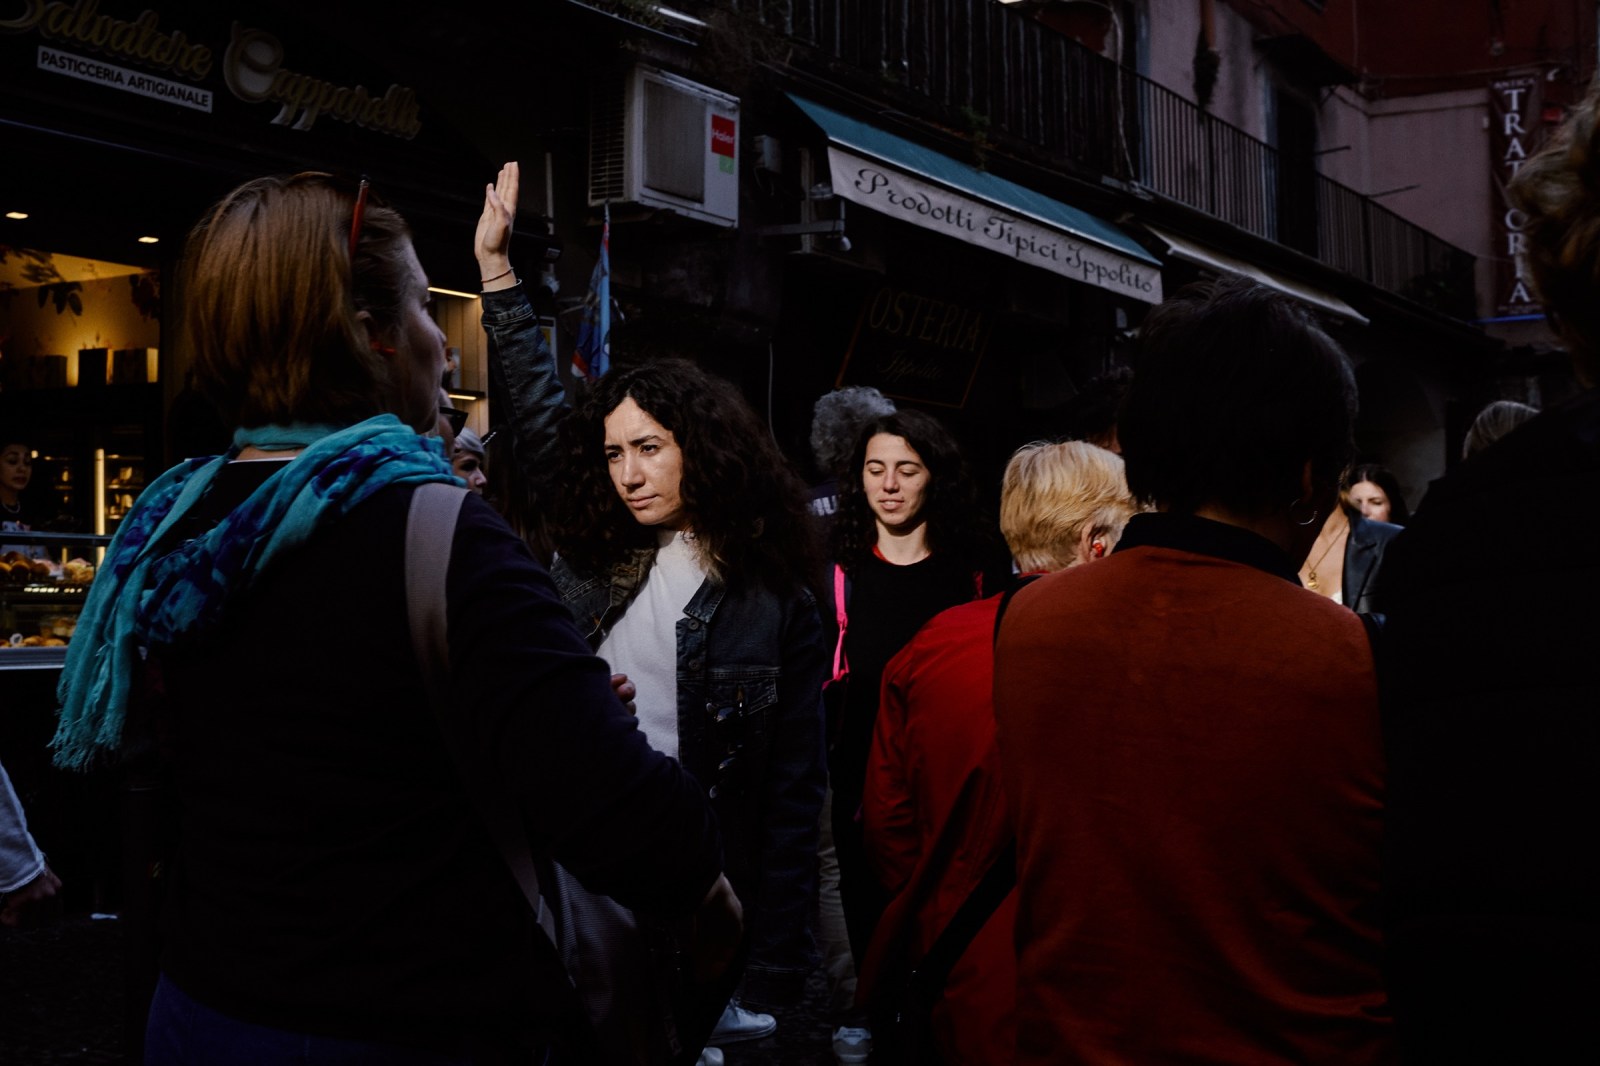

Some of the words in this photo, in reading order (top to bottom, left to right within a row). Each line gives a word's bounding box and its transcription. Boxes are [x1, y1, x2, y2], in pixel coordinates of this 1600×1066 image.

[41, 51, 125, 85] PASTICCERIA
[128, 75, 209, 107] ARTIGIANALE
[855, 168, 975, 231] Prodotti
[984, 215, 1058, 259] Tipici
[1066, 243, 1153, 293] Ippolito
[1503, 88, 1530, 303] TRATORIA
[870, 287, 984, 353] OSTERIA
